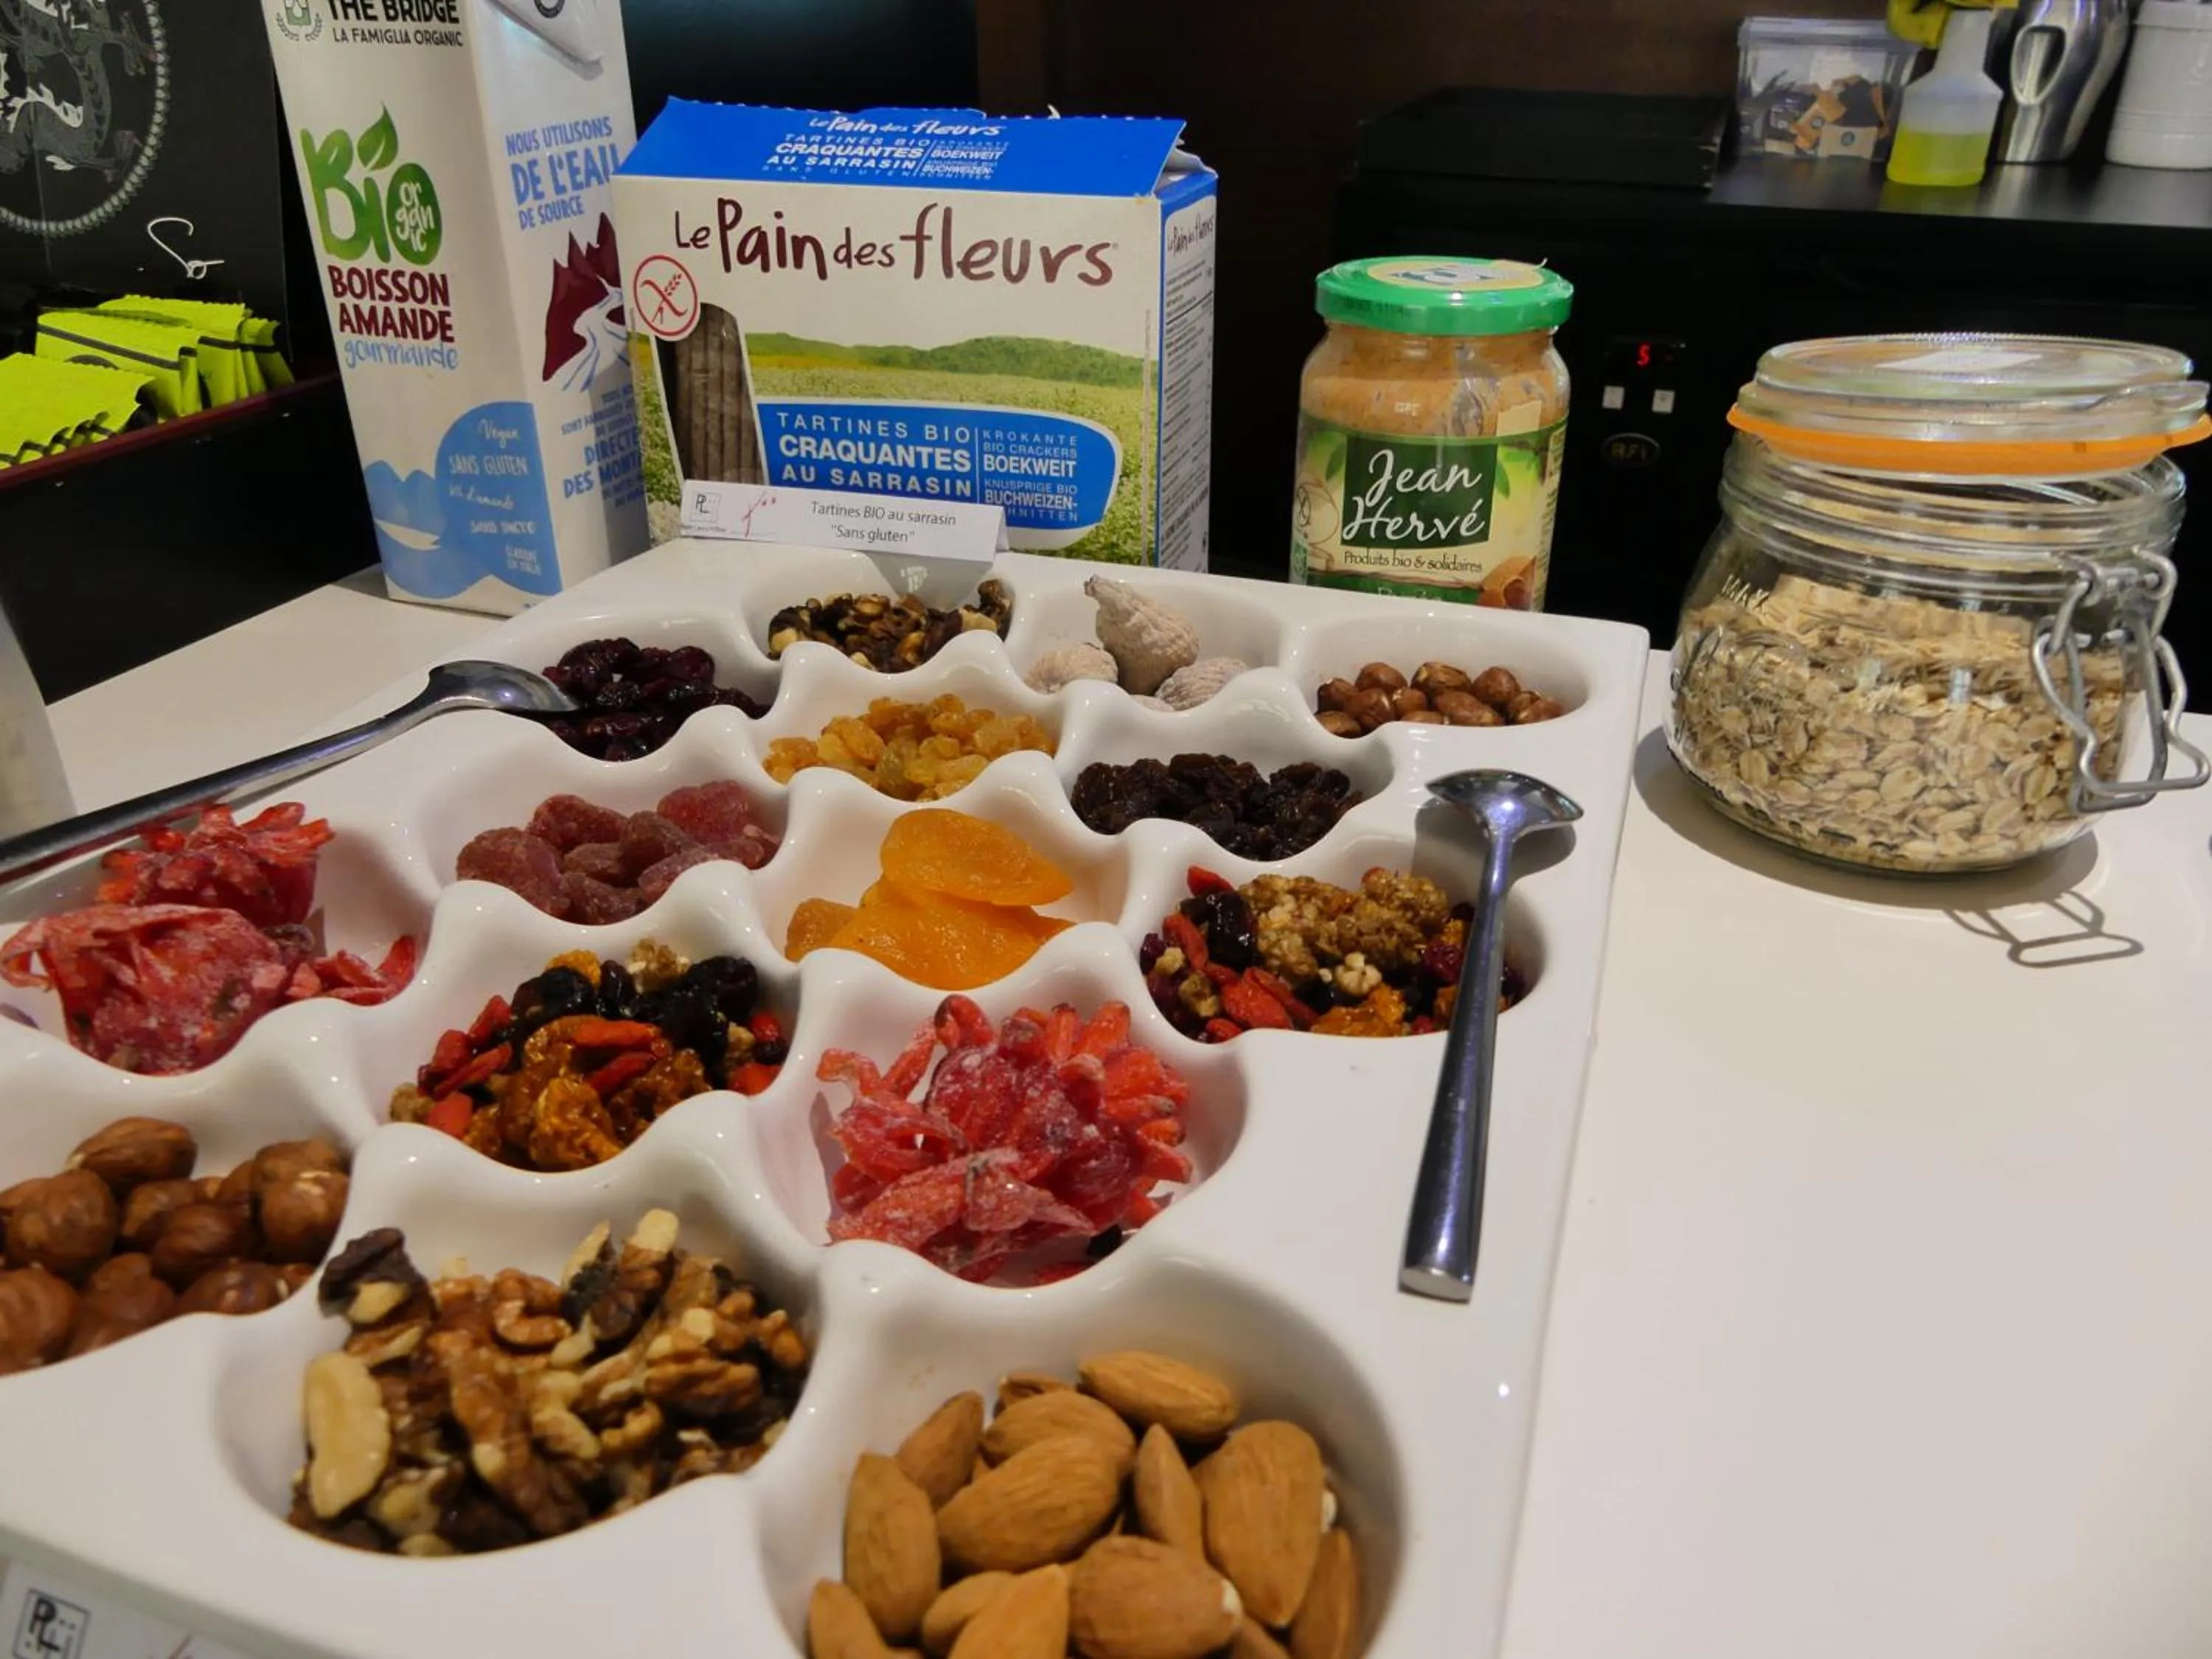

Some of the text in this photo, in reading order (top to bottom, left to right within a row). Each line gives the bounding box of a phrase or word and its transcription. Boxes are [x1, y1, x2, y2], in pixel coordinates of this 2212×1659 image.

[327, 0, 459, 24] THE BRIDGE
[333, 28, 463, 47] LA FAMIGLIA ORGANIC
[505, 116, 613, 156] NOUS UTILISONS
[827, 116, 878, 133] Pain
[912, 119, 1006, 136] fleurs
[775, 142, 925, 159] CRAQUANTES
[785, 133, 884, 146] TARTINES
[766, 155, 796, 165] AU
[805, 156, 917, 170] SARRASIN
[930, 150, 1004, 160] BOEKWEIT
[511, 159, 545, 206] DE
[519, 195, 585, 230] DE SOURCE
[675, 209, 712, 251] Le
[716, 197, 828, 282] Pain
[832, 226, 897, 268] des
[899, 202, 1115, 288] fleurs
[327, 265, 451, 307] BOISSON
[338, 302, 455, 342] AMANDE
[477, 419, 521, 449] Vegan
[776, 412, 970, 444] TARTINES BIO
[982, 430, 1077, 447] KROKANTE
[779, 434, 972, 473] CRAQUANTES
[983, 442, 1077, 459] BIO CRACKERS
[449, 454, 529, 476] SANS GLUTEN
[983, 453, 1077, 479] BOEKWEIT
[563, 470, 594, 499] DES
[782, 464, 972, 497] AU SARRASIN
[984, 478, 1078, 495] KNUSPRIGE BIO
[1365, 448, 1482, 508] Jean
[984, 488, 1079, 510] BUCHWEIZEN-
[811, 501, 956, 526] Tartines BIO au sarrasin
[1007, 507, 1078, 522] HNITTEN
[1342, 495, 1486, 543] Hervé
[832, 524, 916, 544] "Sans gluten"
[1344, 548, 1390, 566] Produits
[1392, 549, 1412, 568] bio
[1427, 553, 1483, 573] solidaires
